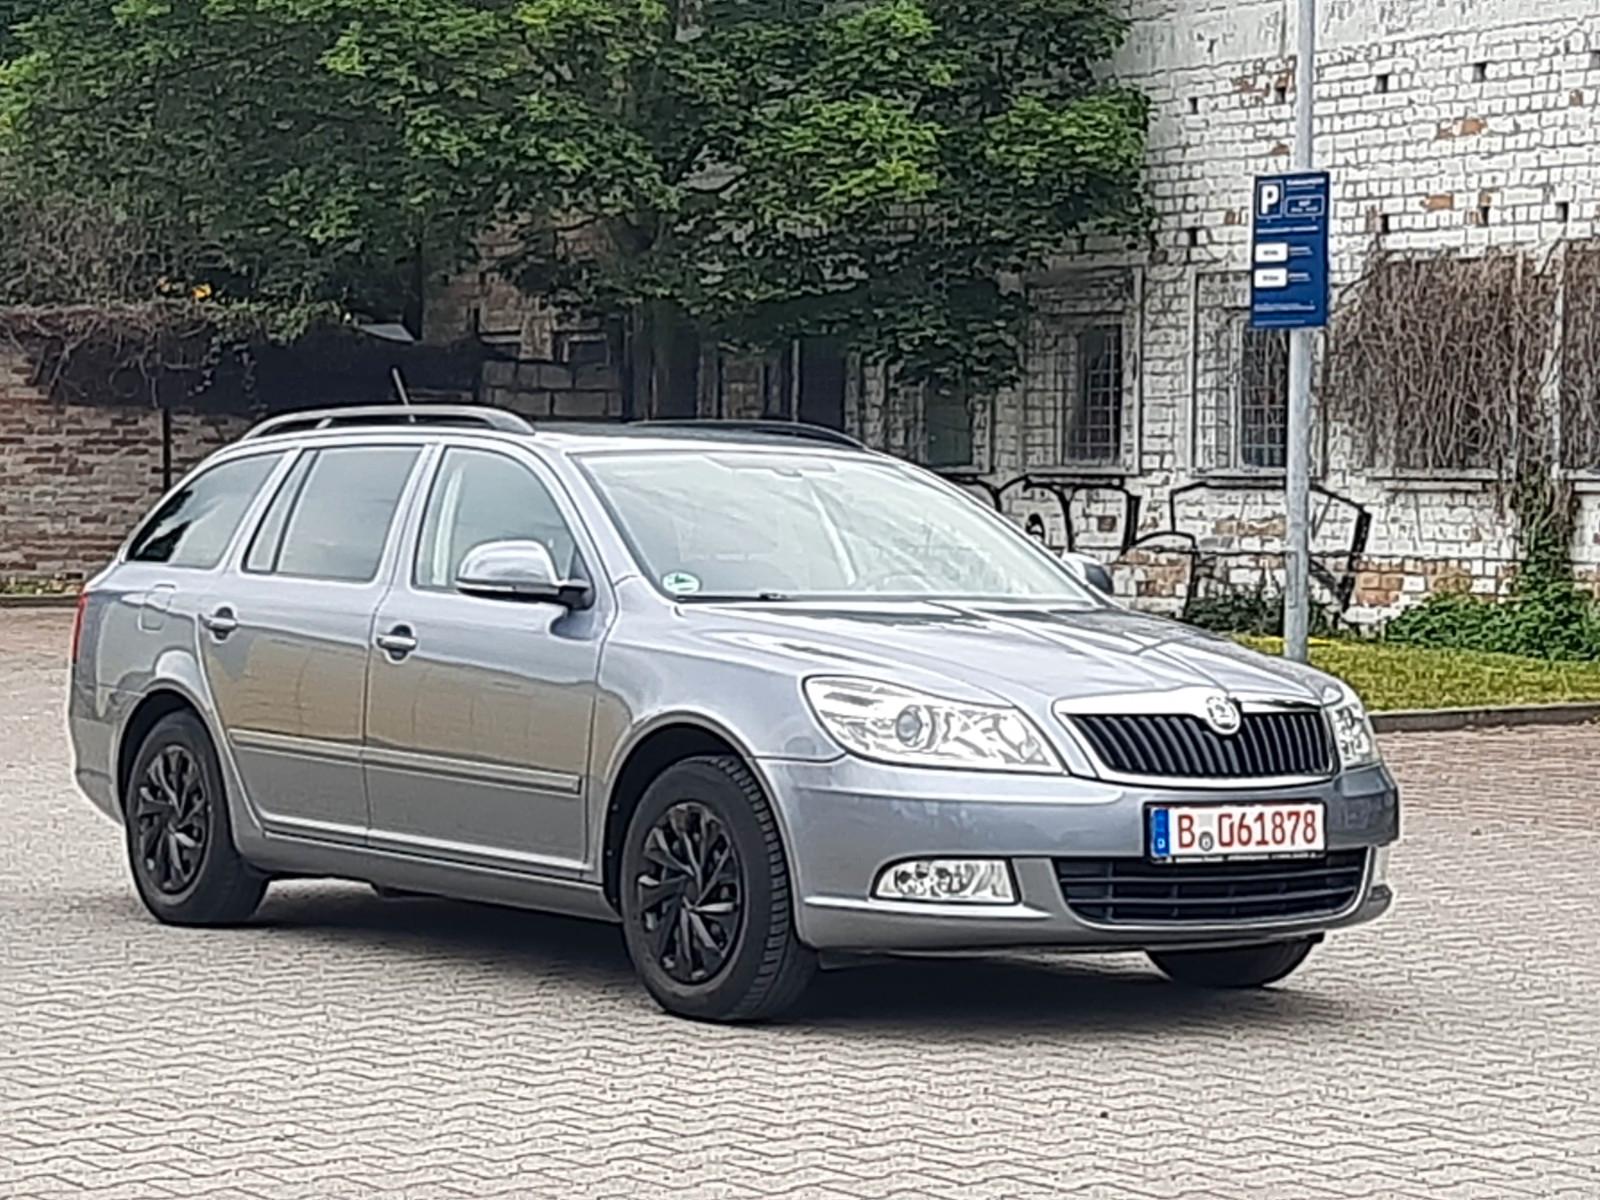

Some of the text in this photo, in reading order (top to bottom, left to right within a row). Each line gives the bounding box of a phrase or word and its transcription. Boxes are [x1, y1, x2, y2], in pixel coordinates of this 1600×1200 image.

[1261, 185, 1279, 214] P
[1178, 810, 1316, 848] B 061878
